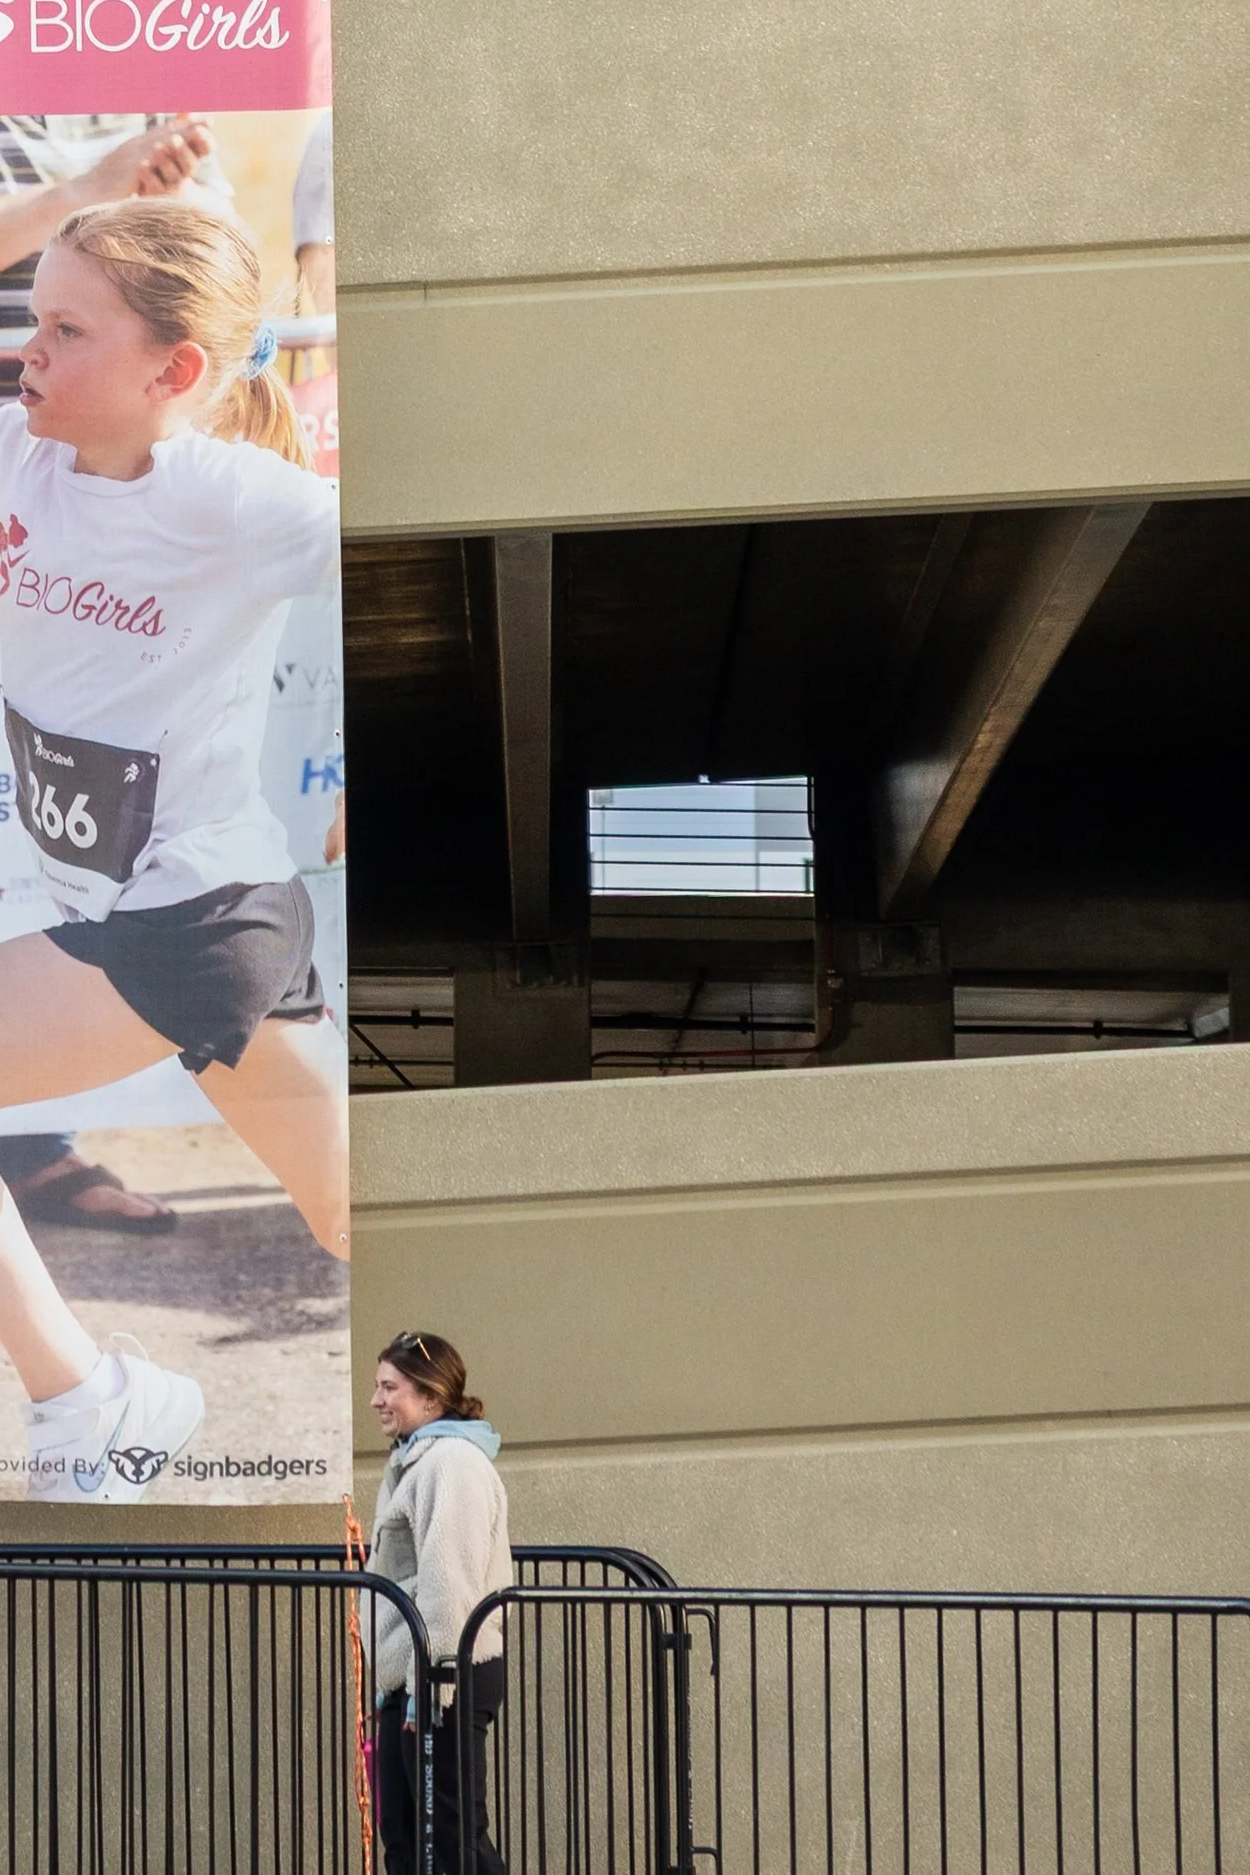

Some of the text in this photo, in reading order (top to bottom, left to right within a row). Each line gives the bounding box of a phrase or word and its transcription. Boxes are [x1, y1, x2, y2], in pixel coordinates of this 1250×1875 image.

[16, 567, 166, 637] BIOGirls
[29, 770, 98, 849] 266
[74, 1458, 106, 1476] By:
[174, 1454, 328, 1481] signbadgers
